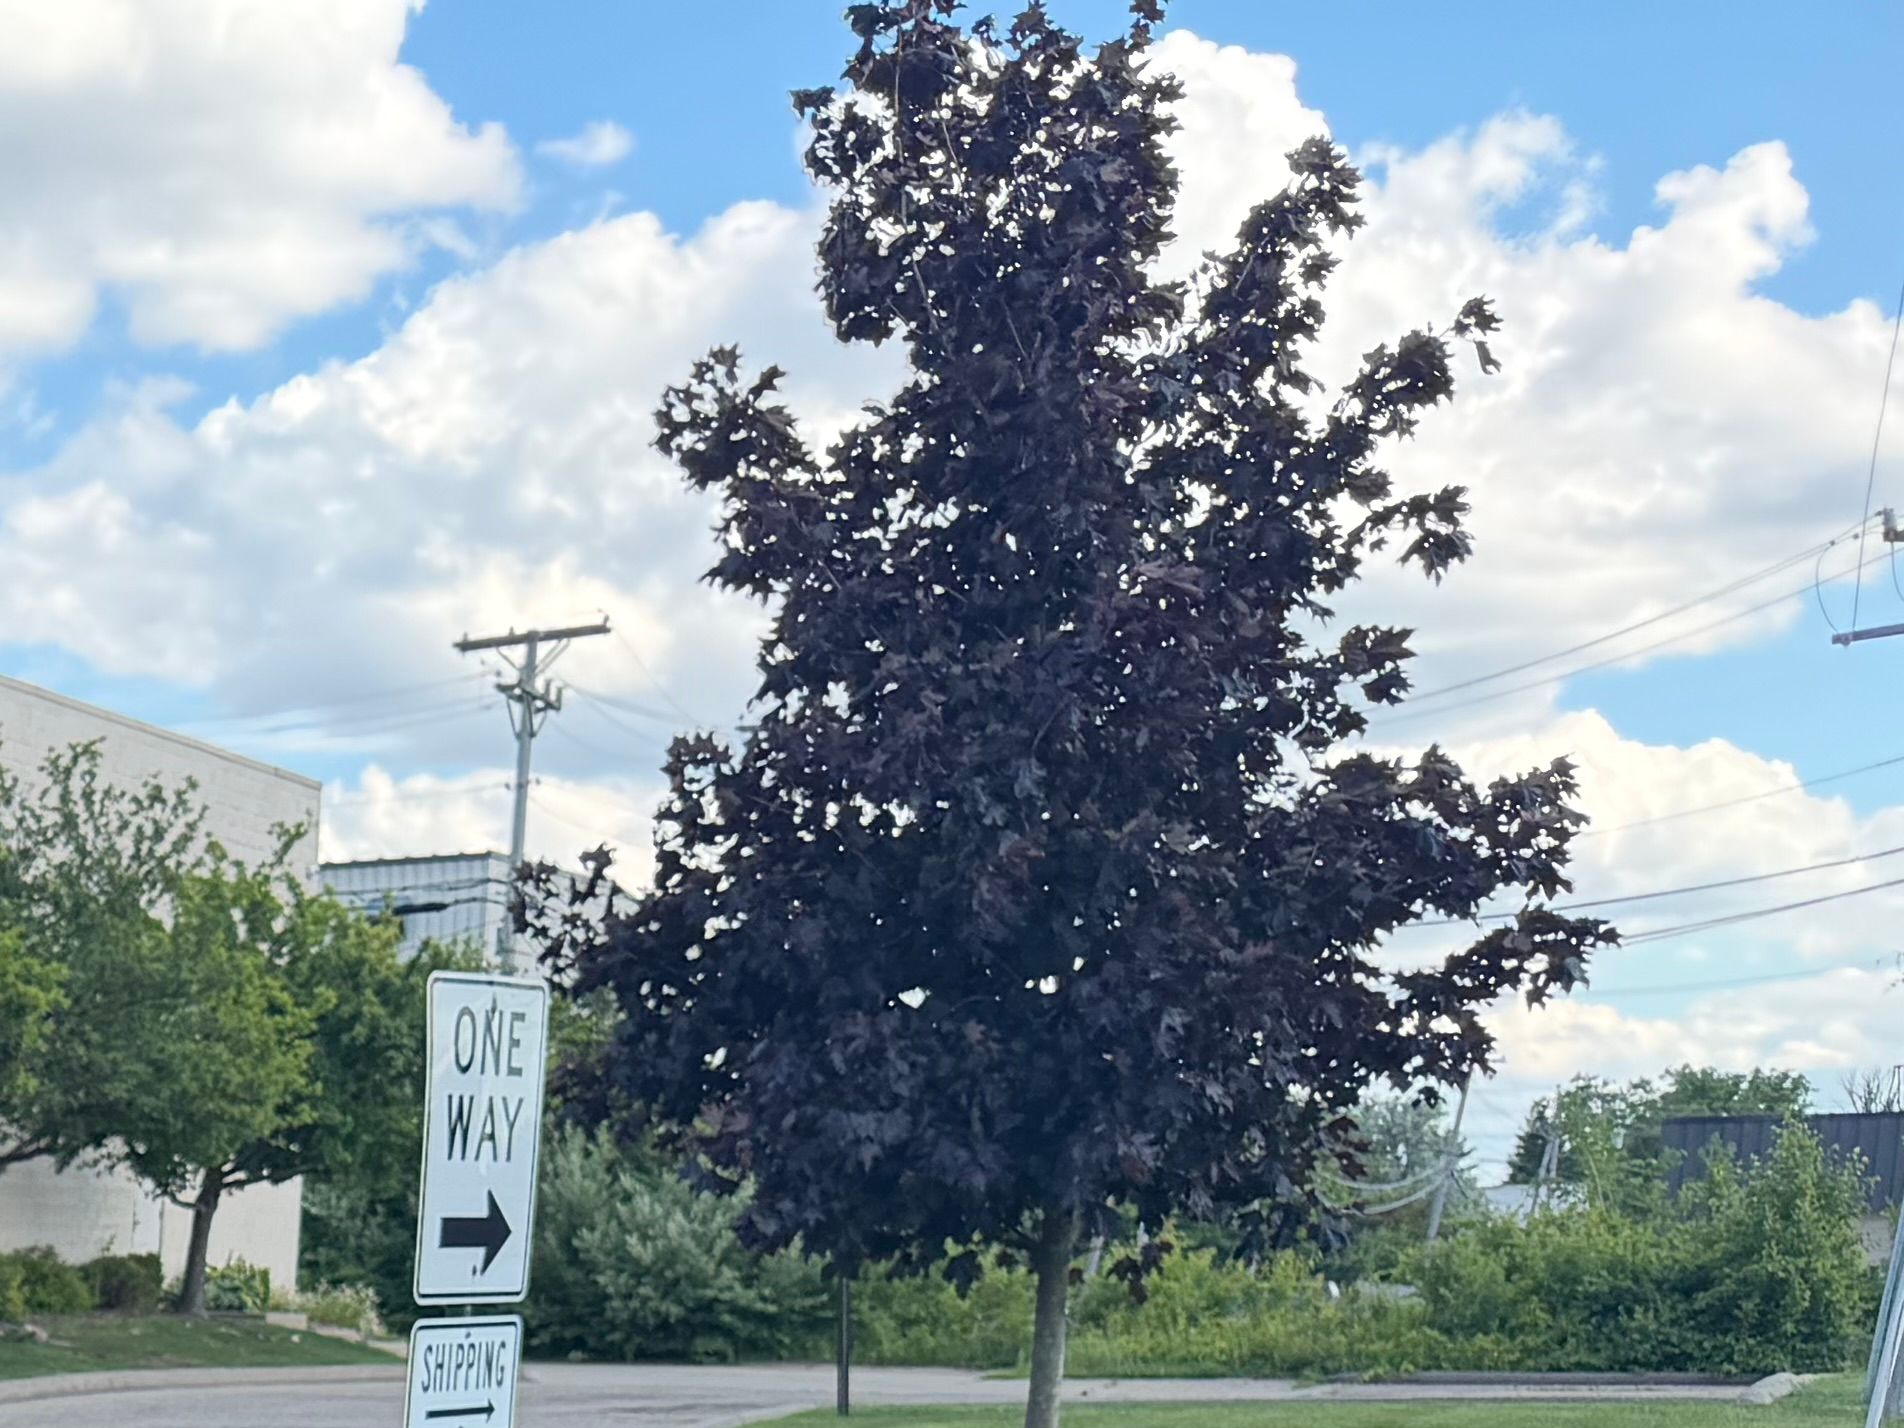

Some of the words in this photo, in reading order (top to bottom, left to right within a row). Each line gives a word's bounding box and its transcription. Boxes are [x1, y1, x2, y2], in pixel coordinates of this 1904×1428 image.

[453, 1005, 527, 1078] ONE
[446, 1093, 525, 1164] WAY
[420, 1339, 506, 1395] SHIPPING
